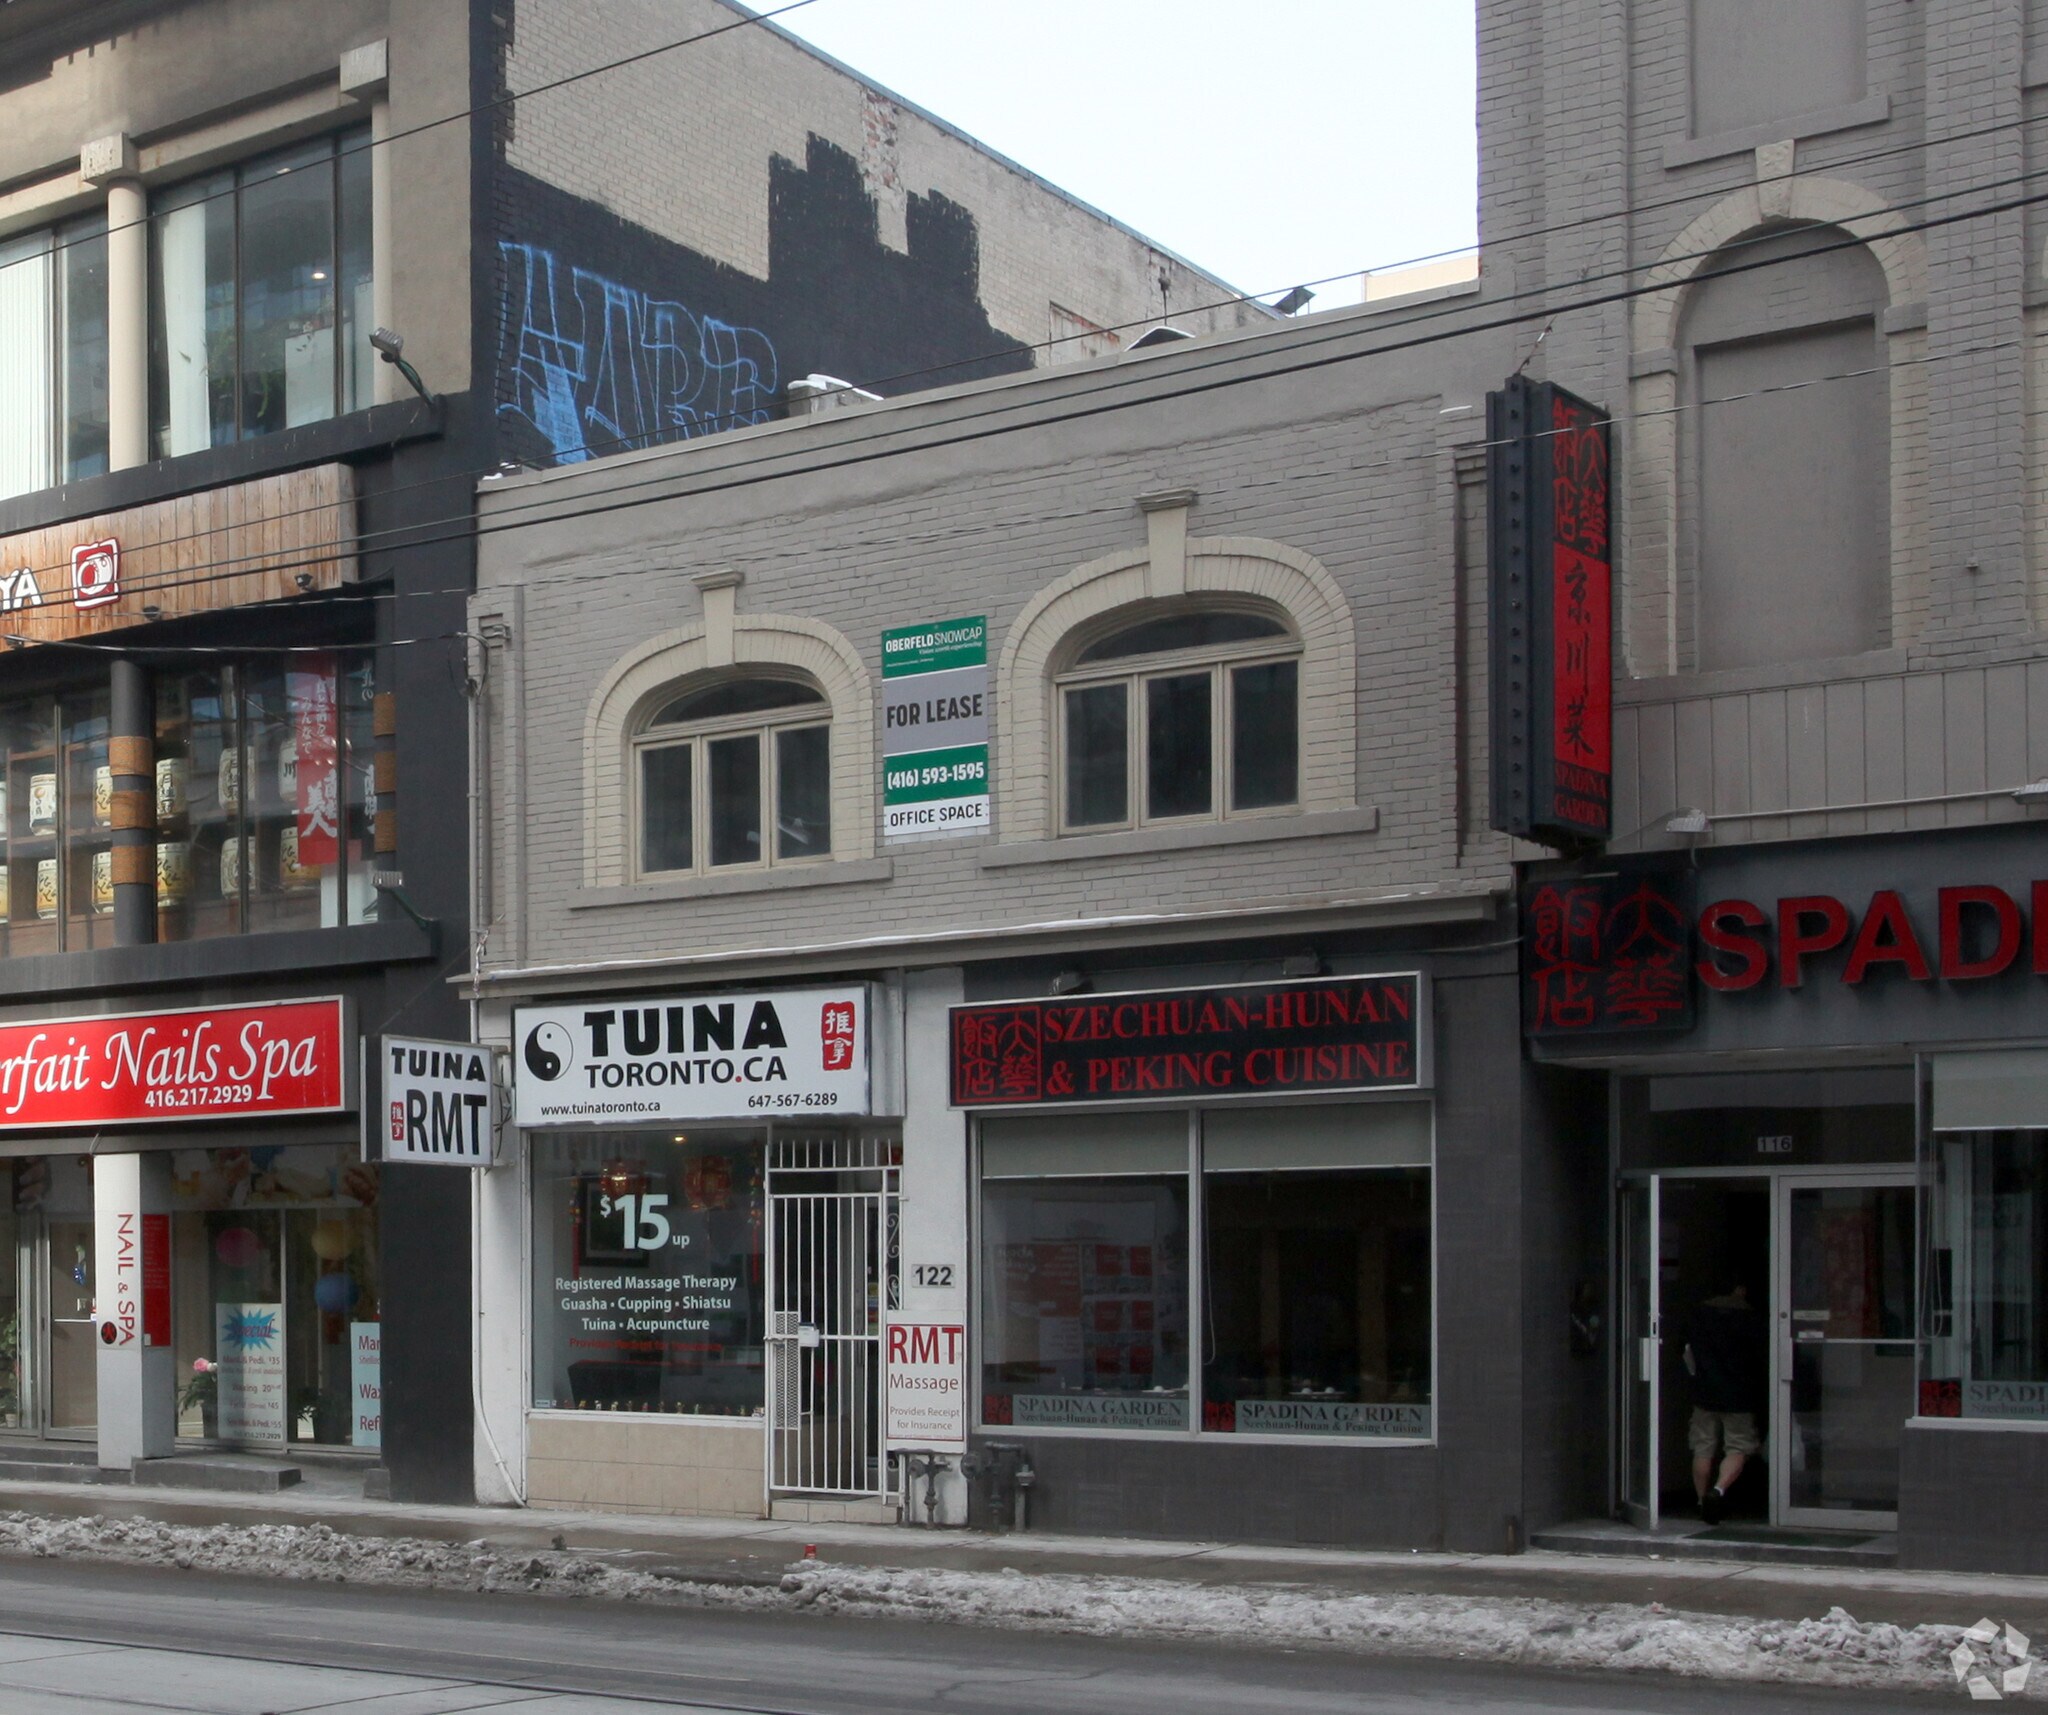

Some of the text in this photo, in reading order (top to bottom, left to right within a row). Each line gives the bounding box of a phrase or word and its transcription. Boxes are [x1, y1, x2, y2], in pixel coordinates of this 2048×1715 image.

[887, 693, 983, 728] FOR LEASE
[887, 762, 984, 790] (416) 593-1595
[890, 803, 982, 827] OFFICE SPACE
[1045, 985, 1411, 1043] SZECHUAN-HUNAN
[584, 1000, 788, 1057] TUINA
[825, 1007, 854, 1065] 推拿
[101, 1021, 221, 1090] Nails
[228, 1021, 318, 1100] Spa
[391, 1046, 486, 1082] TUINA
[1046, 1042, 1410, 1095] & PEKING CUISINE
[584, 1056, 788, 1089] TORONTO.CA
[145, 1085, 252, 1108] 416.217.2929
[541, 1100, 661, 1116] www.tuinatoronto.ca
[748, 1093, 838, 1109] 647-567-6289
[407, 1089, 487, 1155] RMT
[1760, 1136, 1791, 1151] 116
[672, 1234, 690, 1249] up
[117, 1214, 135, 1346] NAIL & SPA
[555, 1275, 737, 1293] Registered Massage Therapy
[914, 1266, 952, 1286] 122
[561, 1296, 731, 1312] Guasha Cupping Shiatsu
[581, 1317, 710, 1333] Tuina Acupuncture
[889, 1326, 962, 1365] RMT
[890, 1373, 959, 1394] Massage
[890, 1406, 960, 1418] Provides Receipt
[1019, 1398, 1098, 1414] SPADINA
[1102, 1399, 1182, 1416] GARDEN
[1242, 1404, 1328, 1420] SPADINA
[1334, 1405, 1422, 1422] GARDEN
[897, 1420, 953, 1431] for Insurance
